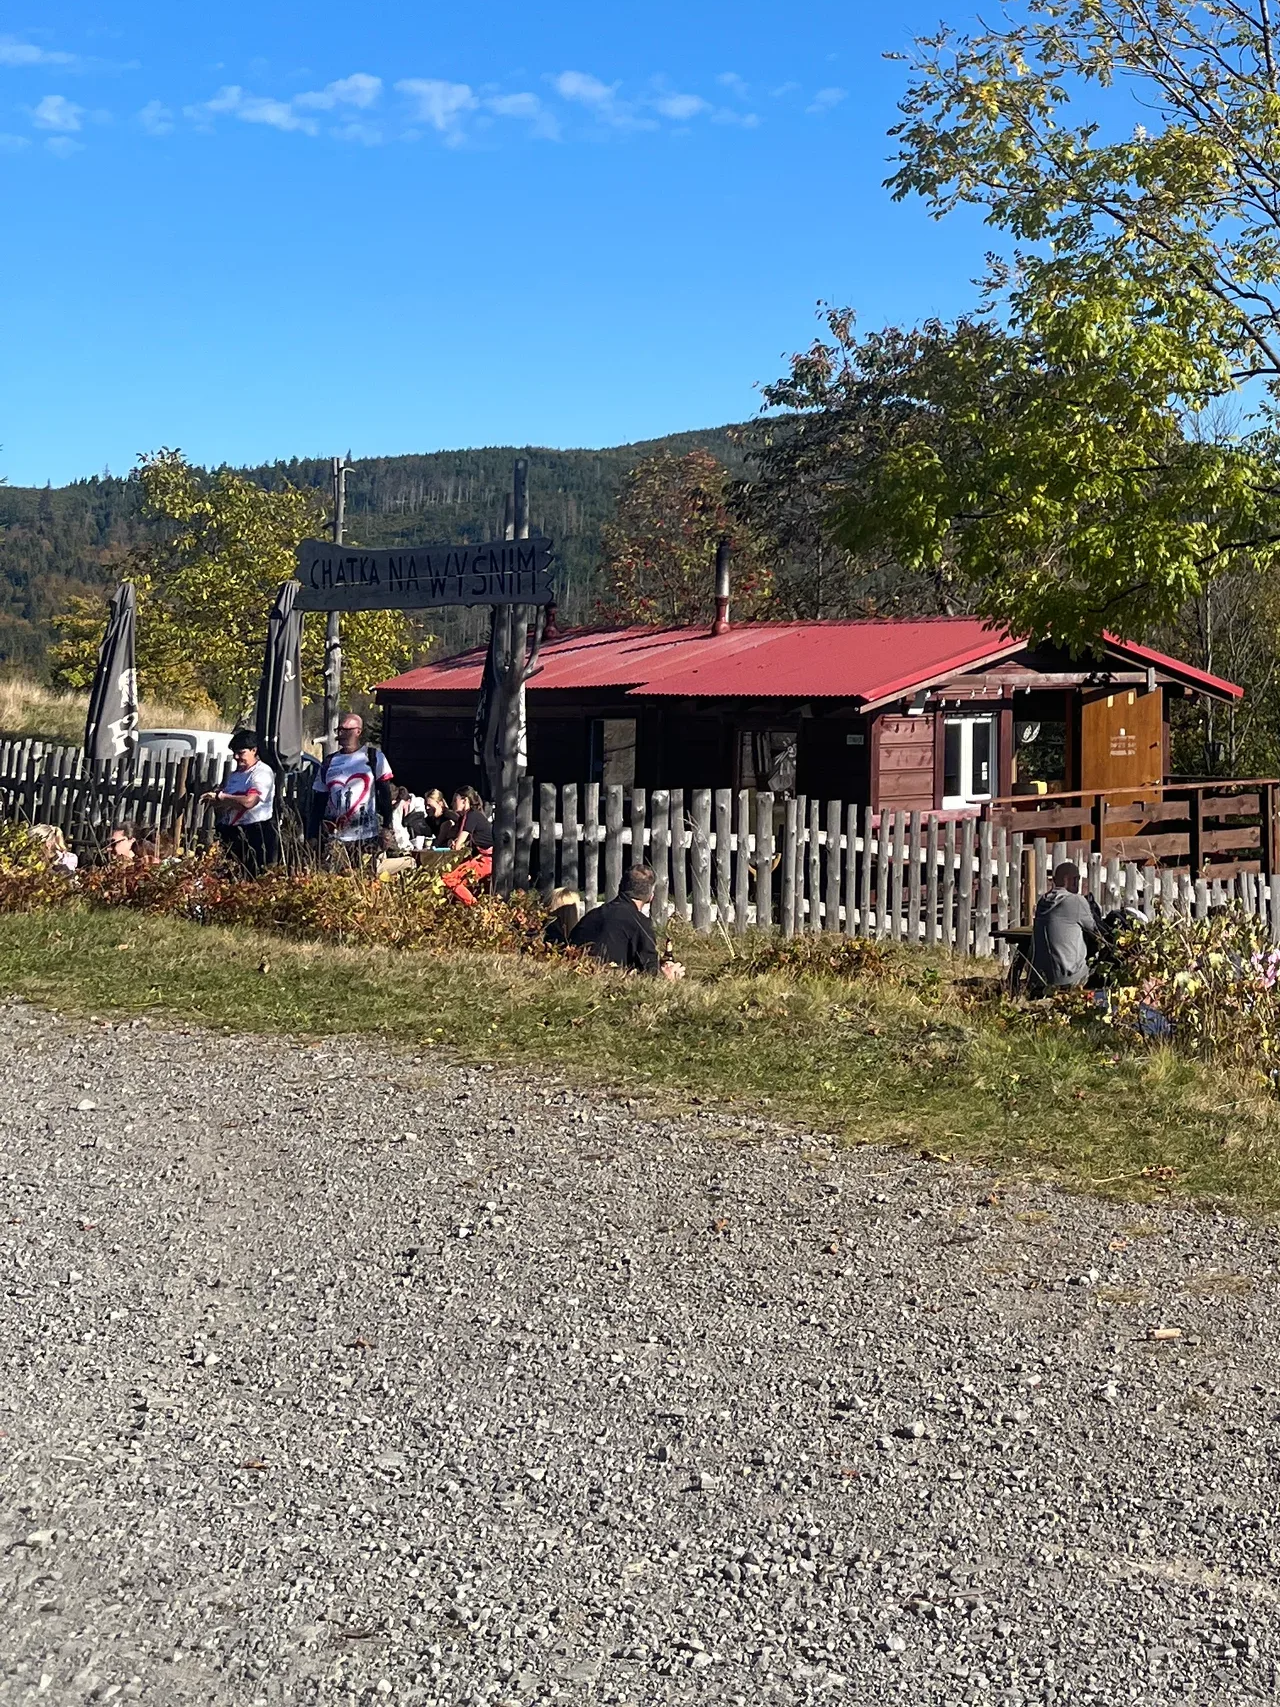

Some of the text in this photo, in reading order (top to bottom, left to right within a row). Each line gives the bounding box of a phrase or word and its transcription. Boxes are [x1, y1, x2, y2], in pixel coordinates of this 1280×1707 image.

[310, 545, 537, 598] CHATKA NA WYŚNIM
